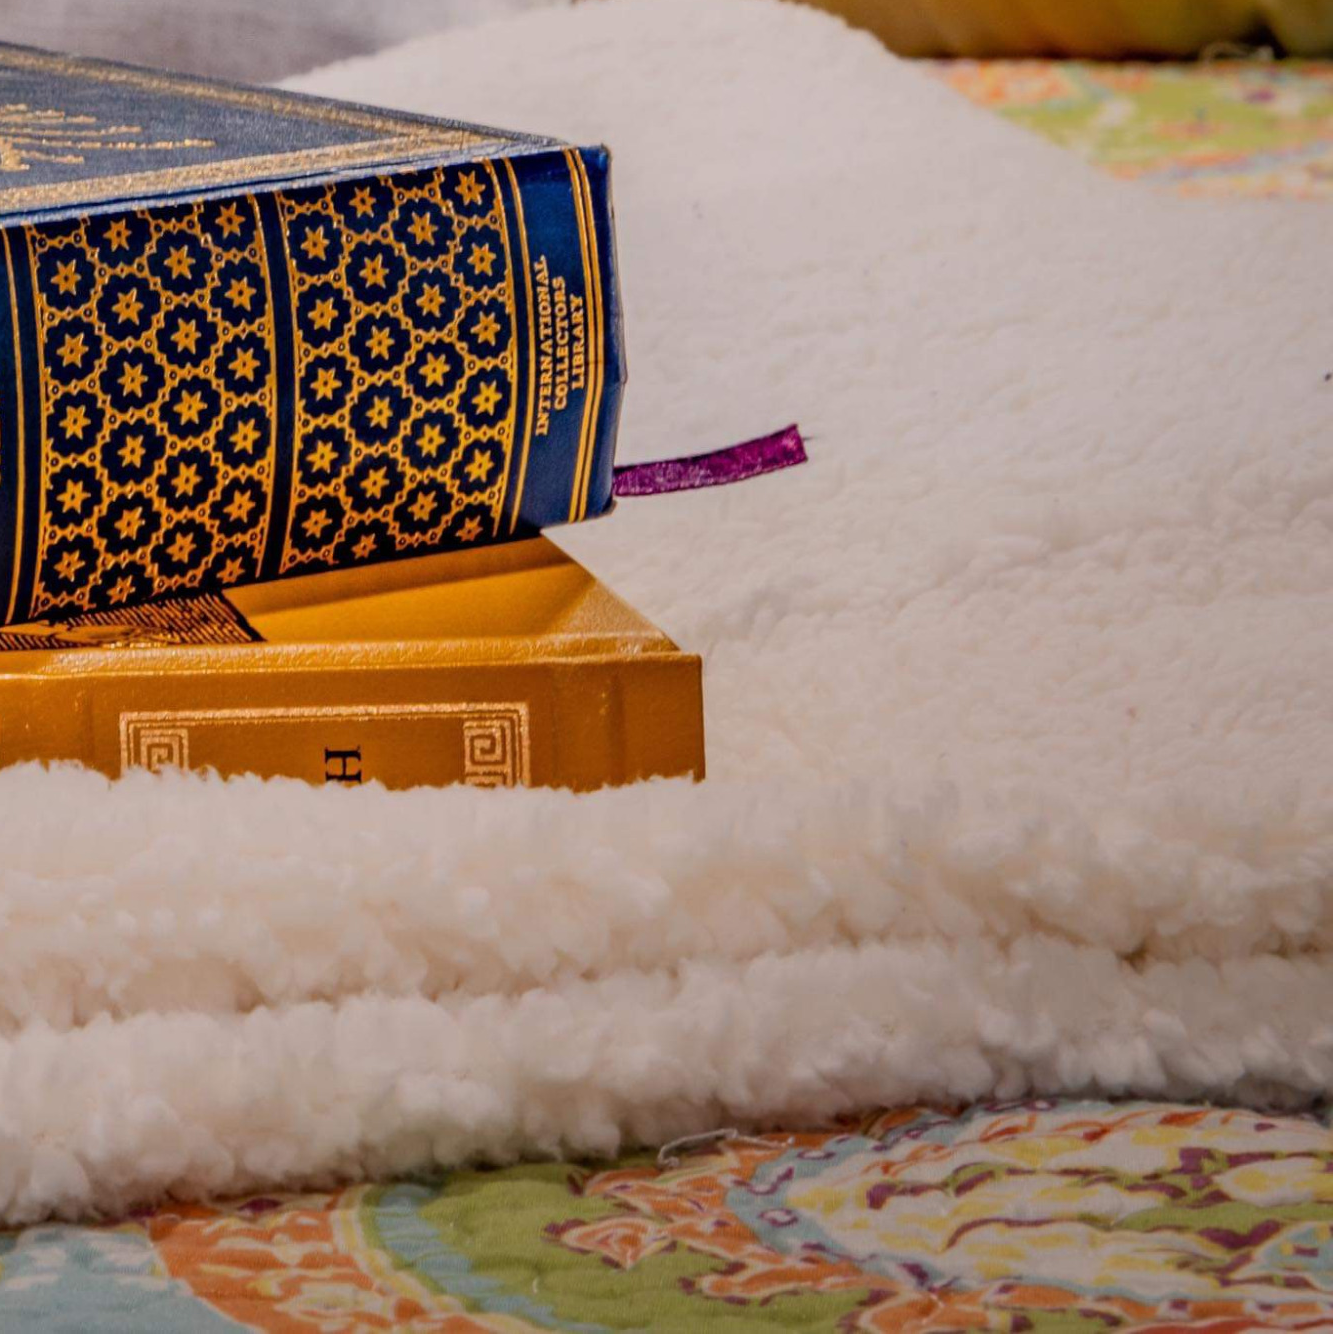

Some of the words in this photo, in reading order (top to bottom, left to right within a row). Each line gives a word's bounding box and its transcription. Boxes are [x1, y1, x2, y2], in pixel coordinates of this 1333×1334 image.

[534, 254, 553, 436] INTERNATIONAL
[552, 275, 569, 411] COLLECTORS
[570, 293, 585, 390] LIBRARY
